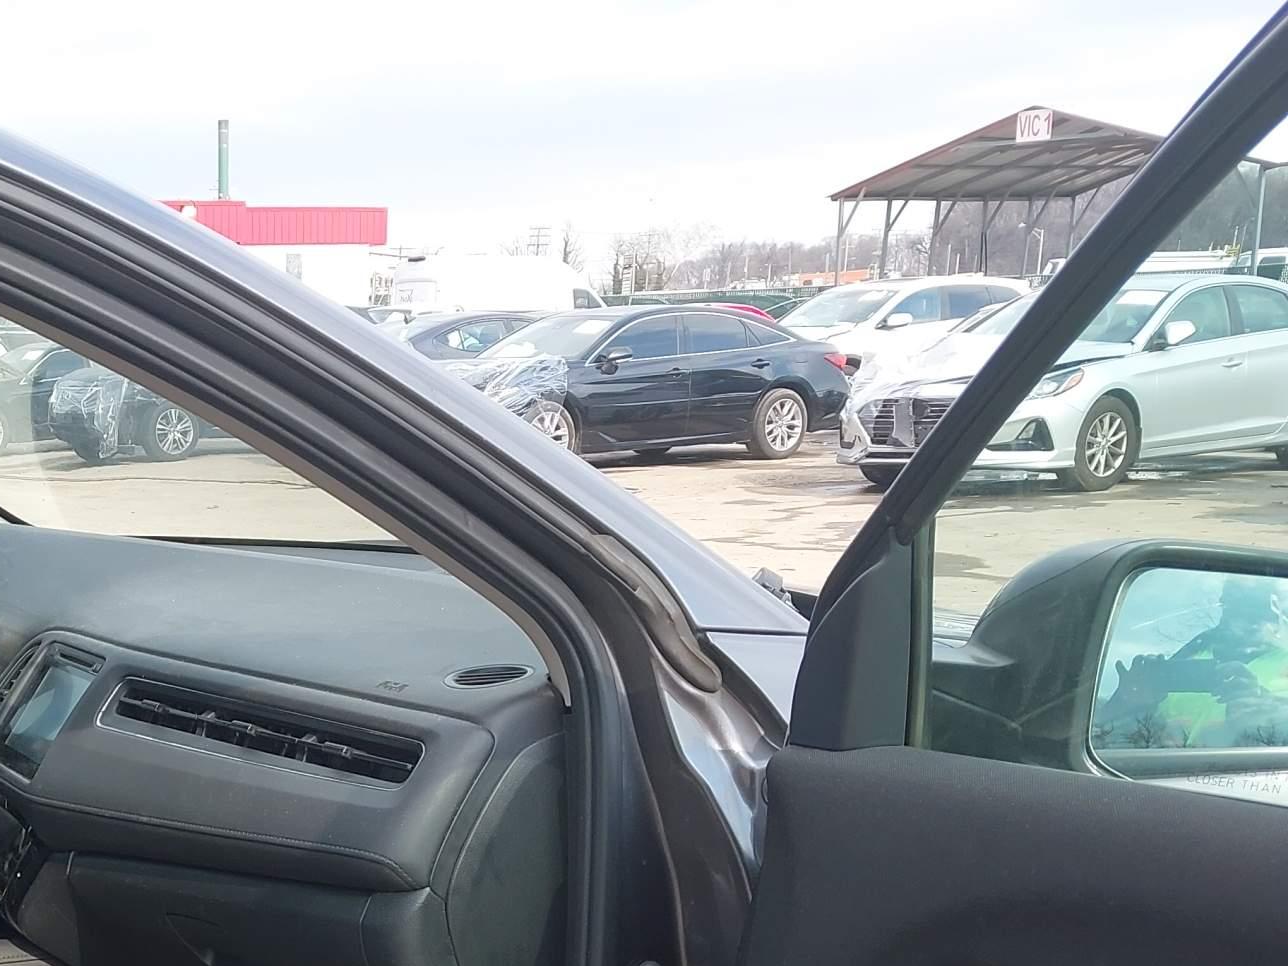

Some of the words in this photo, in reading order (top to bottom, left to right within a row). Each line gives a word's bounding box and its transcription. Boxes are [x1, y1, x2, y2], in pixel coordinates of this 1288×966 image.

[1019, 115, 1041, 137] VIC
[1044, 113, 1052, 135] 1
[1241, 779, 1282, 795] THAN
